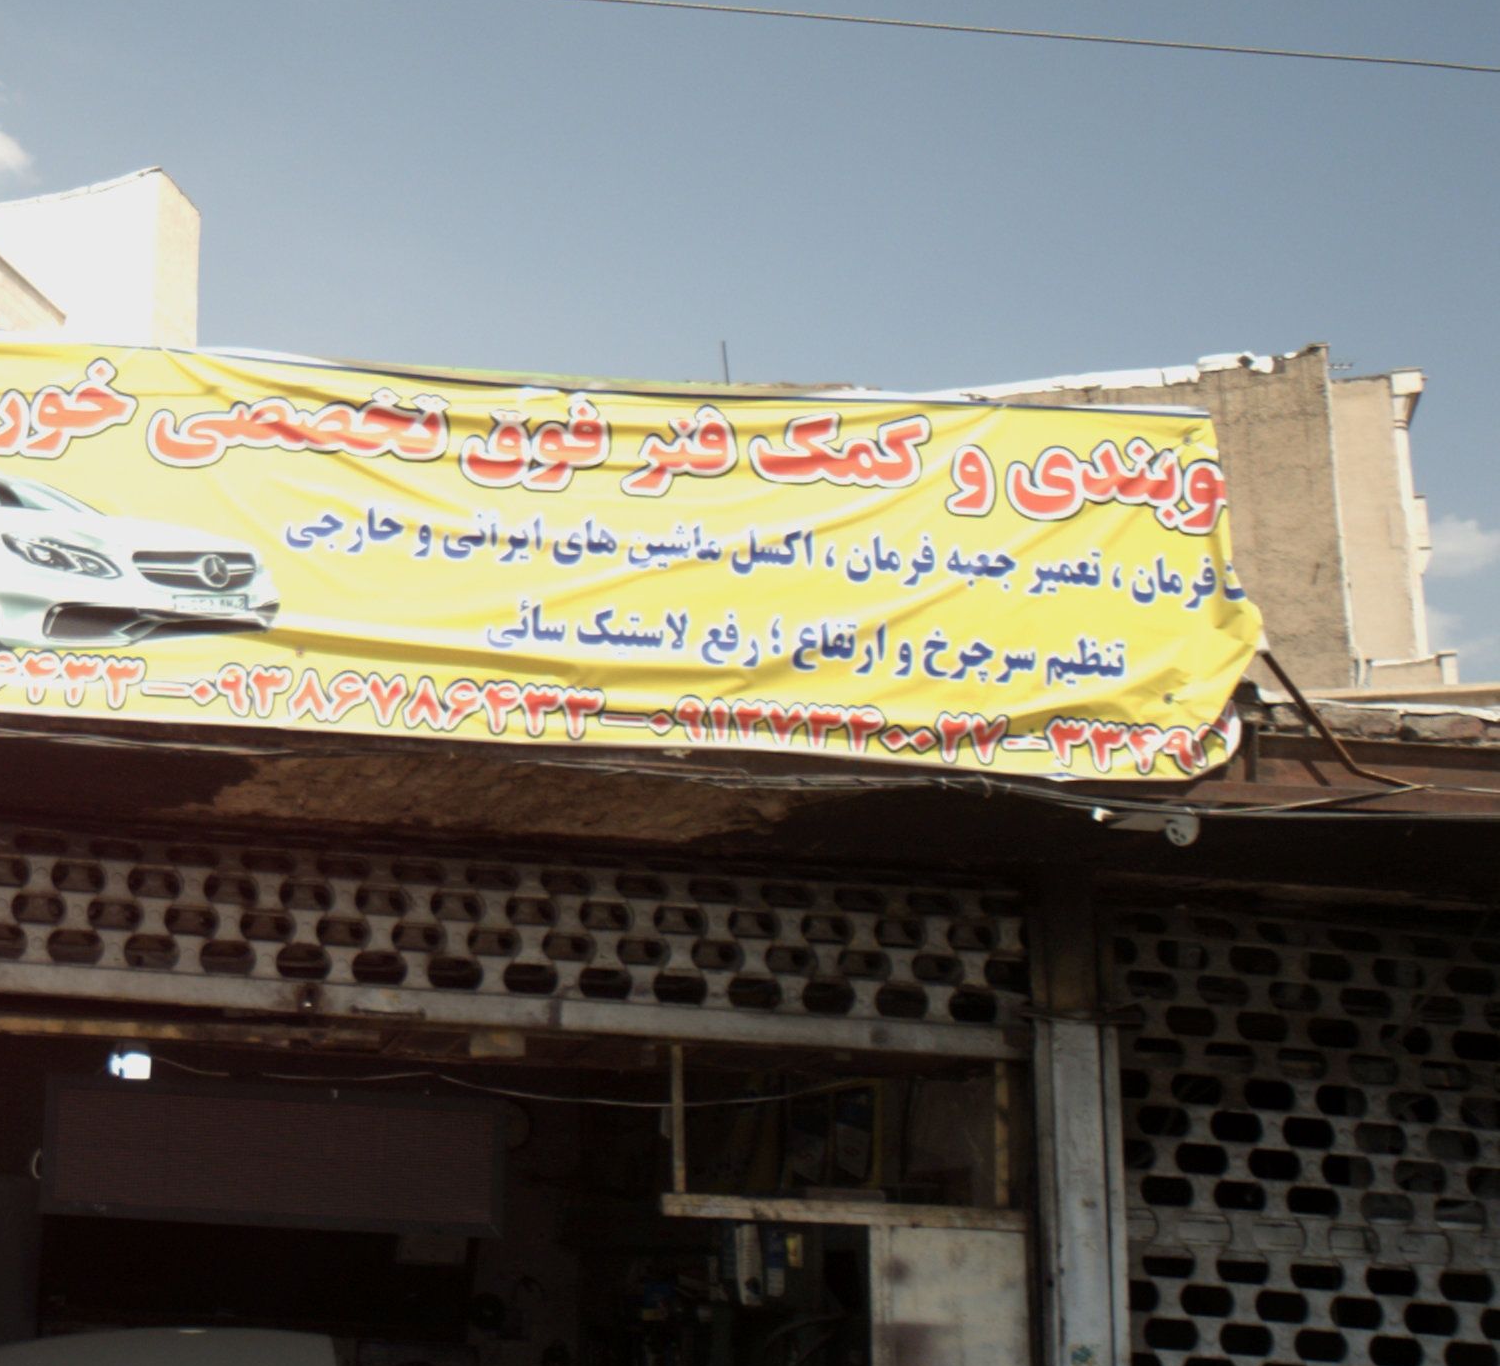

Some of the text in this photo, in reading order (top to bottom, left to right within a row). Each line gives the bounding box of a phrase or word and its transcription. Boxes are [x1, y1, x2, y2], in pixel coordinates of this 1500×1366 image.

[145, 388, 448, 469] تخصصی
[460, 393, 610, 492] فوق
[621, 405, 737, 497] فنر
[748, 413, 931, 488] کمک
[945, 444, 996, 517] و
[1005, 437, 1227, 535] وبندی
[414, 524, 432, 557] و
[443, 512, 542, 562] ایرانی
[553, 519, 618, 565] های
[628, 524, 723, 569] ماشین
[731, 529, 813, 574] اکسل
[846, 535, 936, 586] فرمان
[947, 549, 1016, 590] جعبه
[1028, 551, 1101, 594] تعمیر
[1132, 557, 1217, 609] فرمان
[577, 609, 689, 656] لاستیک
[701, 613, 760, 668] رفع
[793, 623, 887, 673] ارتفاع
[895, 642, 913, 676] و
[1046, 638, 1126, 686] تنظیم
